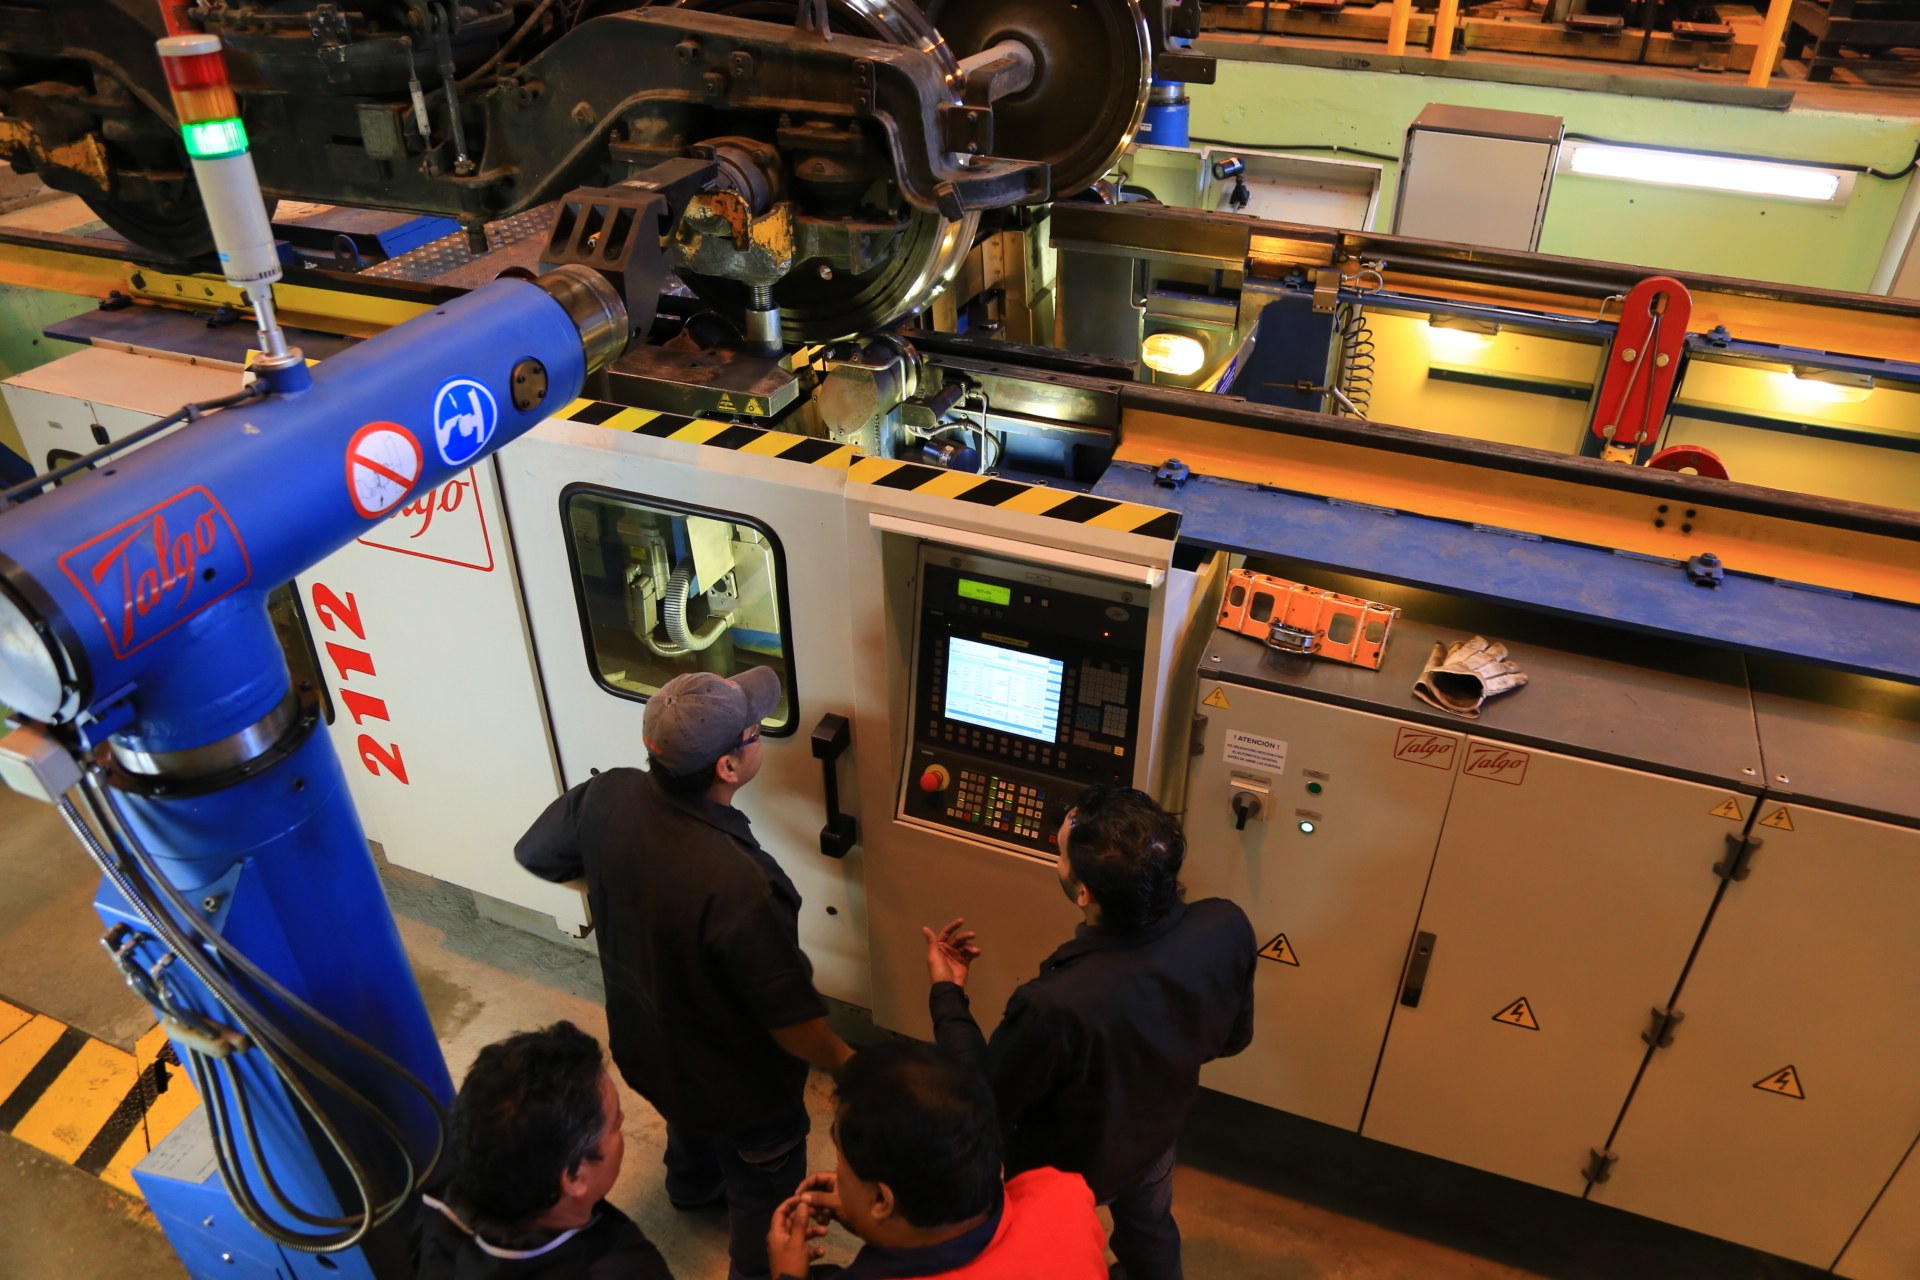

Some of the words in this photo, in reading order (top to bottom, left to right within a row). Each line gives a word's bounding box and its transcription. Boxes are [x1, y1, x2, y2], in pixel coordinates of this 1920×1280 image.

[92, 508, 217, 649] Talgo
[312, 583, 410, 785] 2112
[1397, 734, 1454, 759] Talgo
[1467, 749, 1526, 774] Talgo
